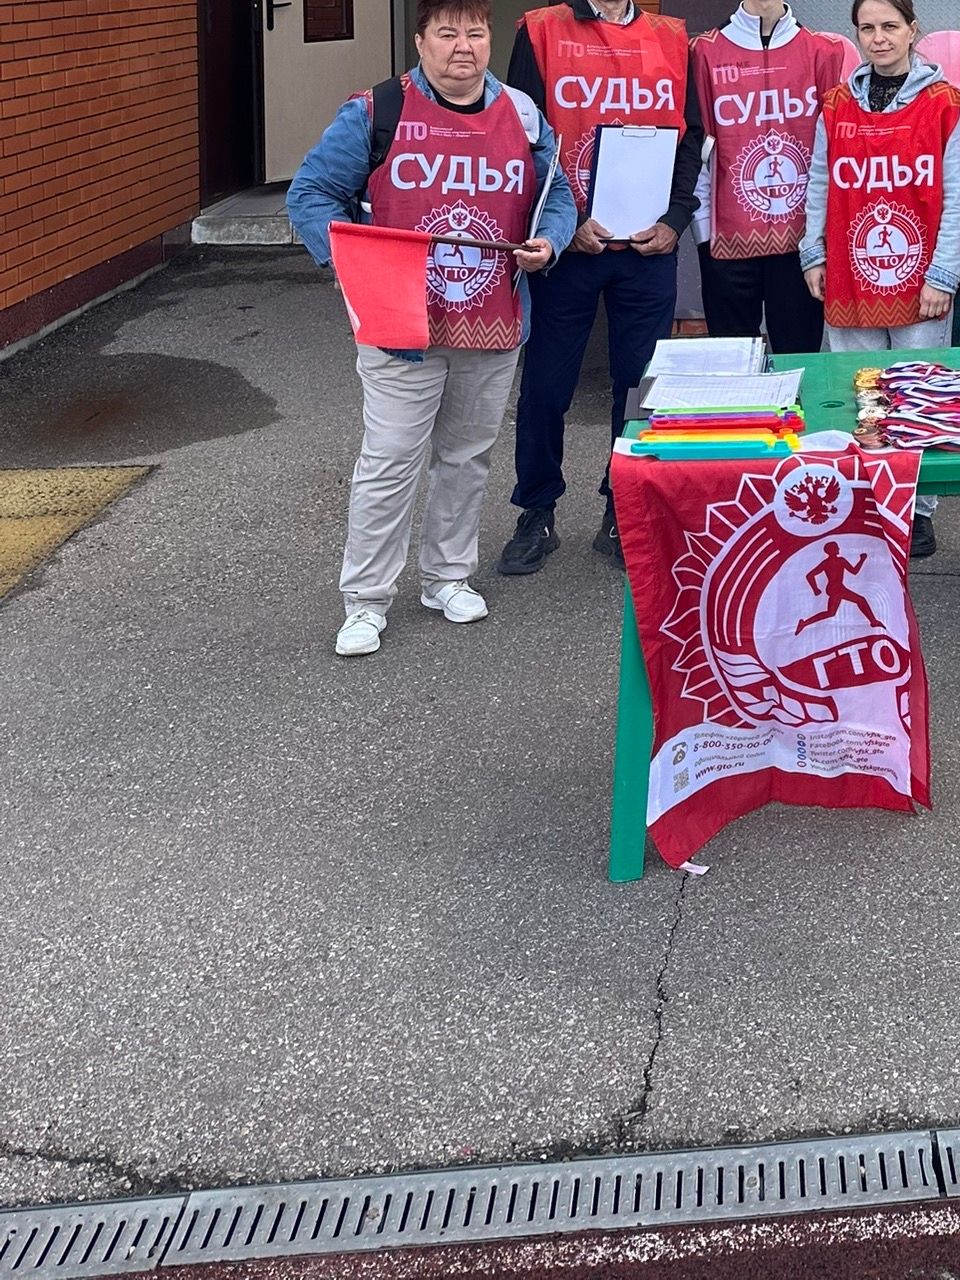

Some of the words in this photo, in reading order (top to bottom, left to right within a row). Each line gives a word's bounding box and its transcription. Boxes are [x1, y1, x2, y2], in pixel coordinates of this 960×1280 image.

[557, 40, 585, 58] ГТО
[712, 65, 740, 85] ГТО
[554, 75, 675, 115] СУДЬЯ
[713, 85, 818, 126] СУДЬЯ
[394, 121, 428, 141] ГТО
[390, 152, 525, 197] СУДЬЯ
[832, 154, 935, 194] СУДЬЯ
[767, 185, 790, 196] ГТО
[876, 256, 899, 266] ГТО
[444, 267, 469, 280] ГТО
[812, 639, 901, 689] ГТО
[695, 761, 745, 780] www.gto.ru
